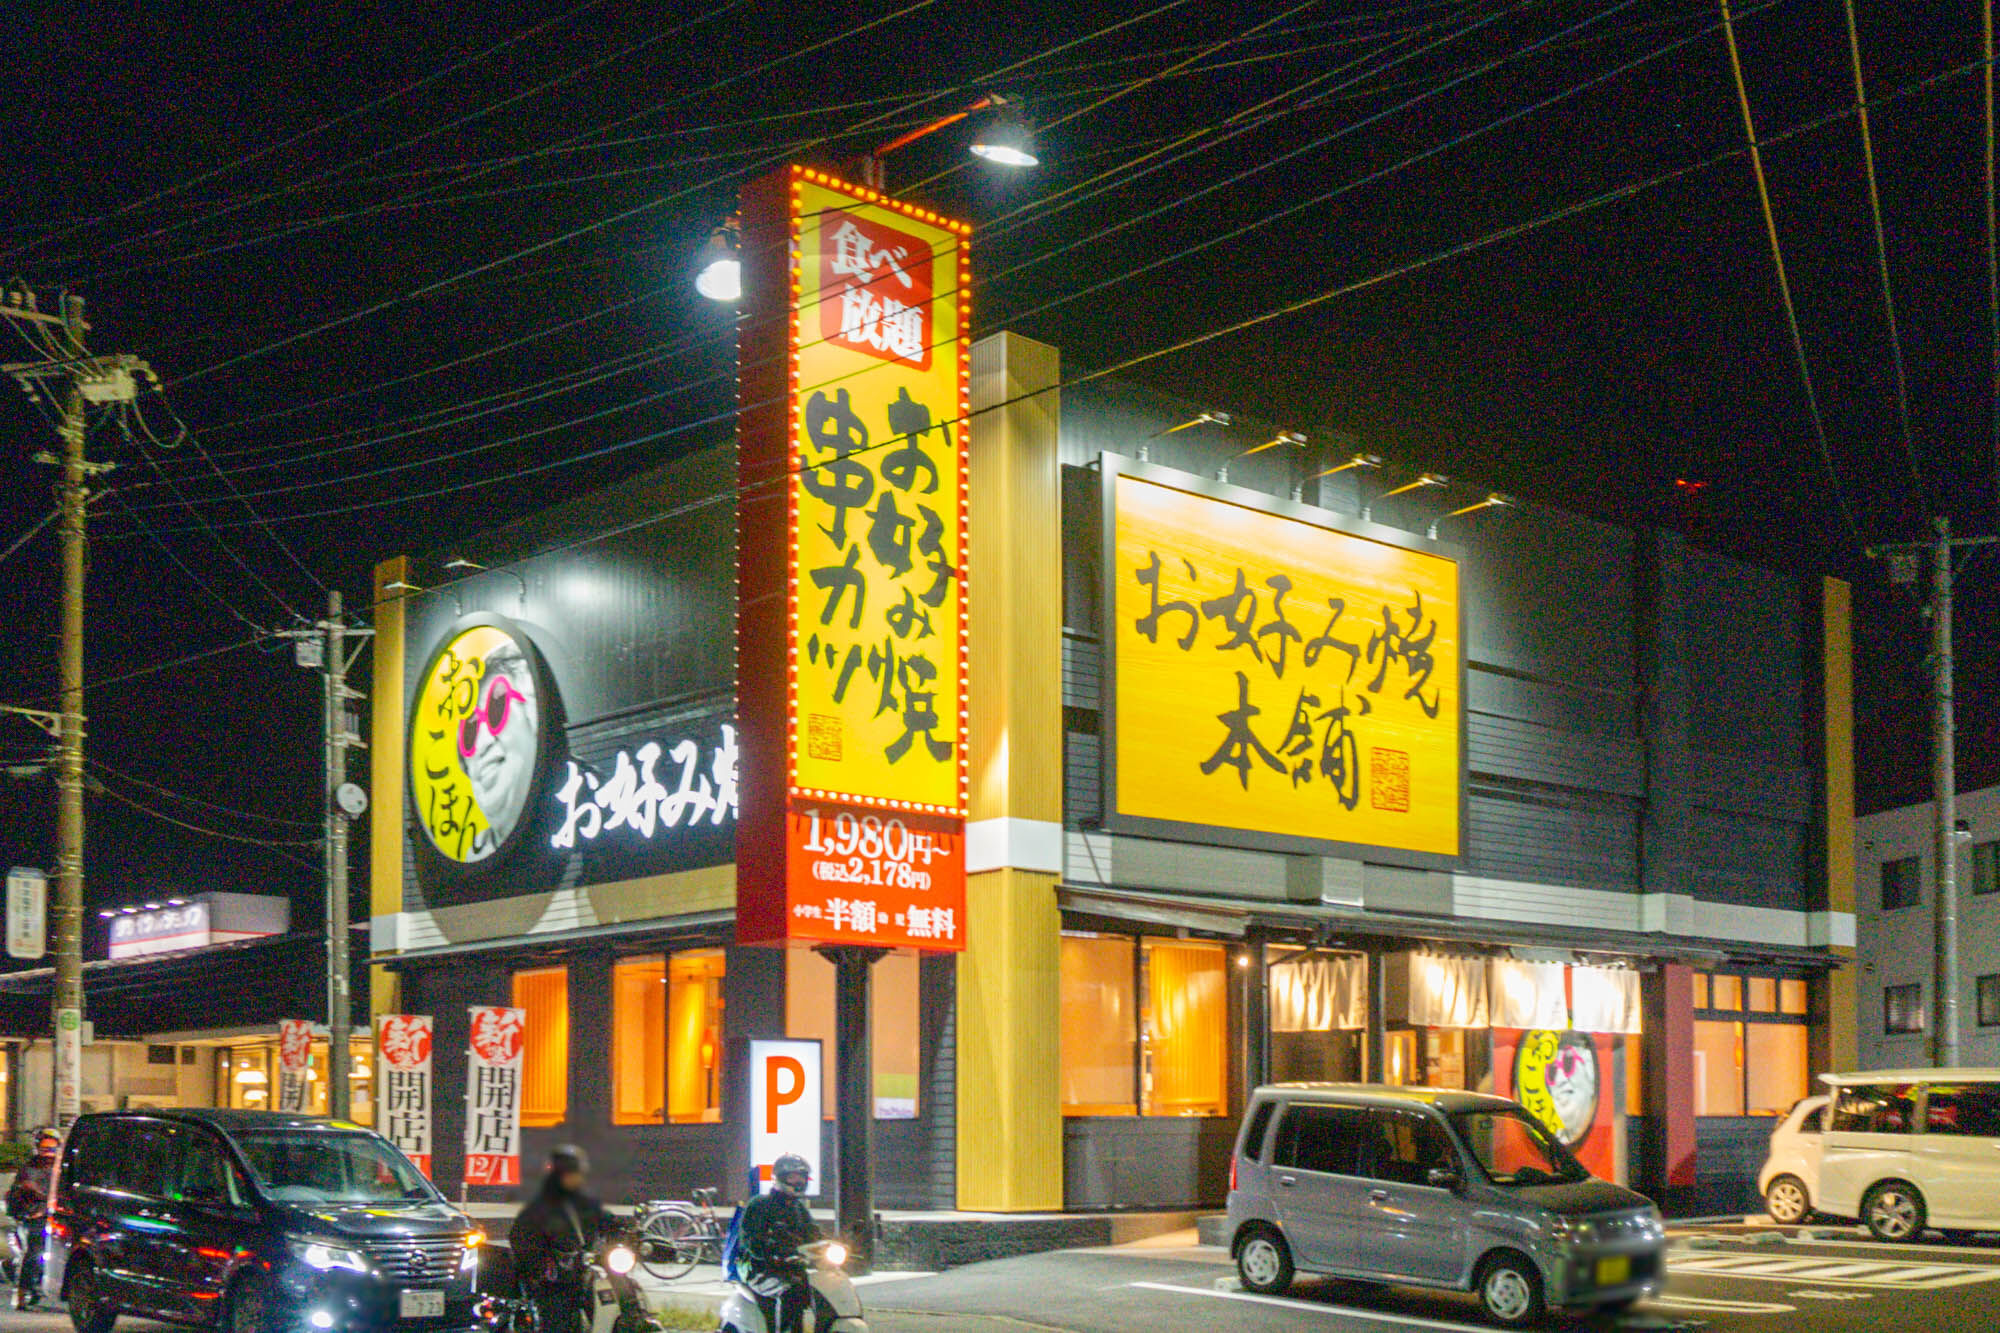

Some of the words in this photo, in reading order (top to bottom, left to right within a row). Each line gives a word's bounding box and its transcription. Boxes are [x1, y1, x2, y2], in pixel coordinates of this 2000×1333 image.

[829, 220, 912, 289] 食べ
[840, 282, 925, 363] 放題
[800, 387, 875, 705] 串カツ
[1135, 550, 1441, 719] お好み焼
[1199, 670, 1371, 812] 本舗
[766, 1055, 806, 1133] P
[466, 1155, 512, 1184] 12/1
